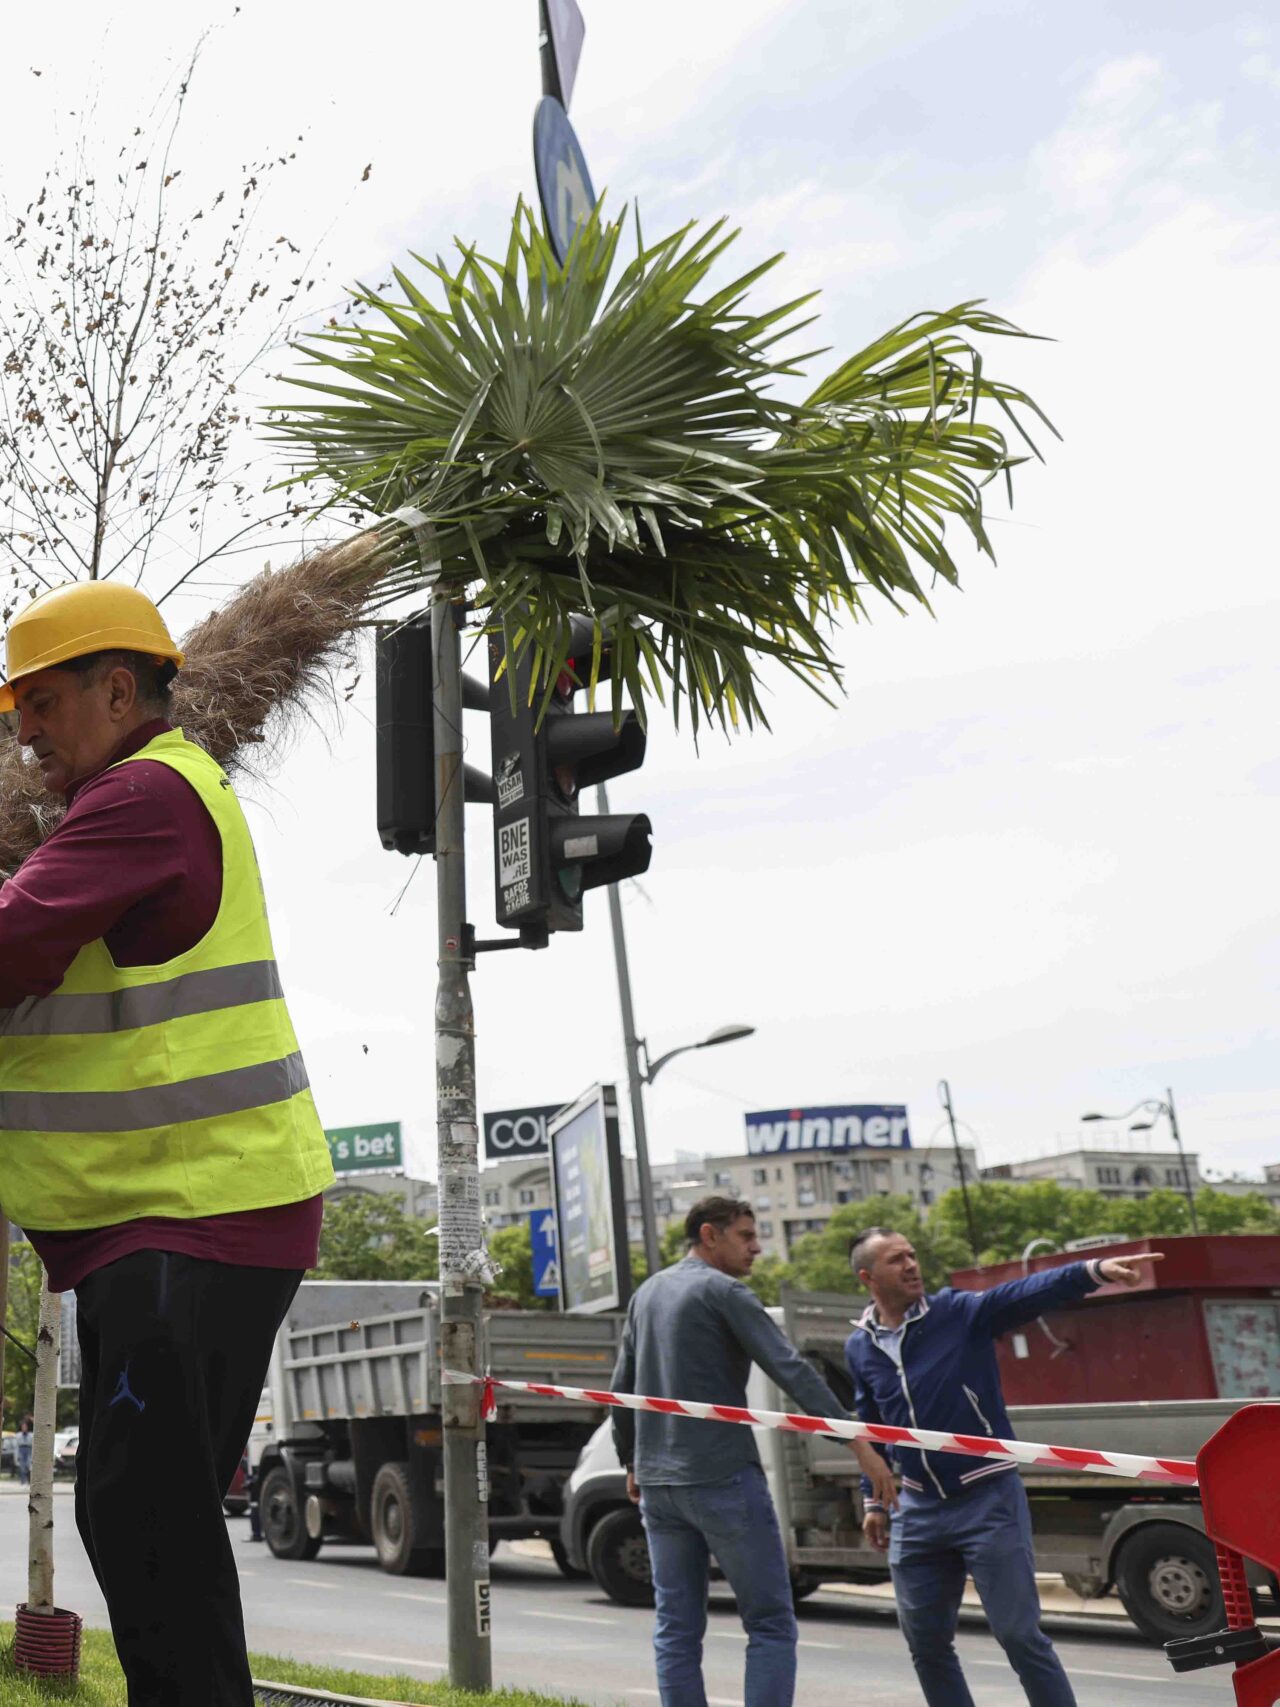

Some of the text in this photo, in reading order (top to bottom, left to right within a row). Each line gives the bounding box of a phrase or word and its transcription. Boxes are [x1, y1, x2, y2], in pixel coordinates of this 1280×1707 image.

[501, 822, 527, 854] BNE
[502, 847, 528, 868] WAS
[354, 1132, 396, 1157] bet
[490, 1114, 548, 1150] COL
[746, 1109, 908, 1154] winner
